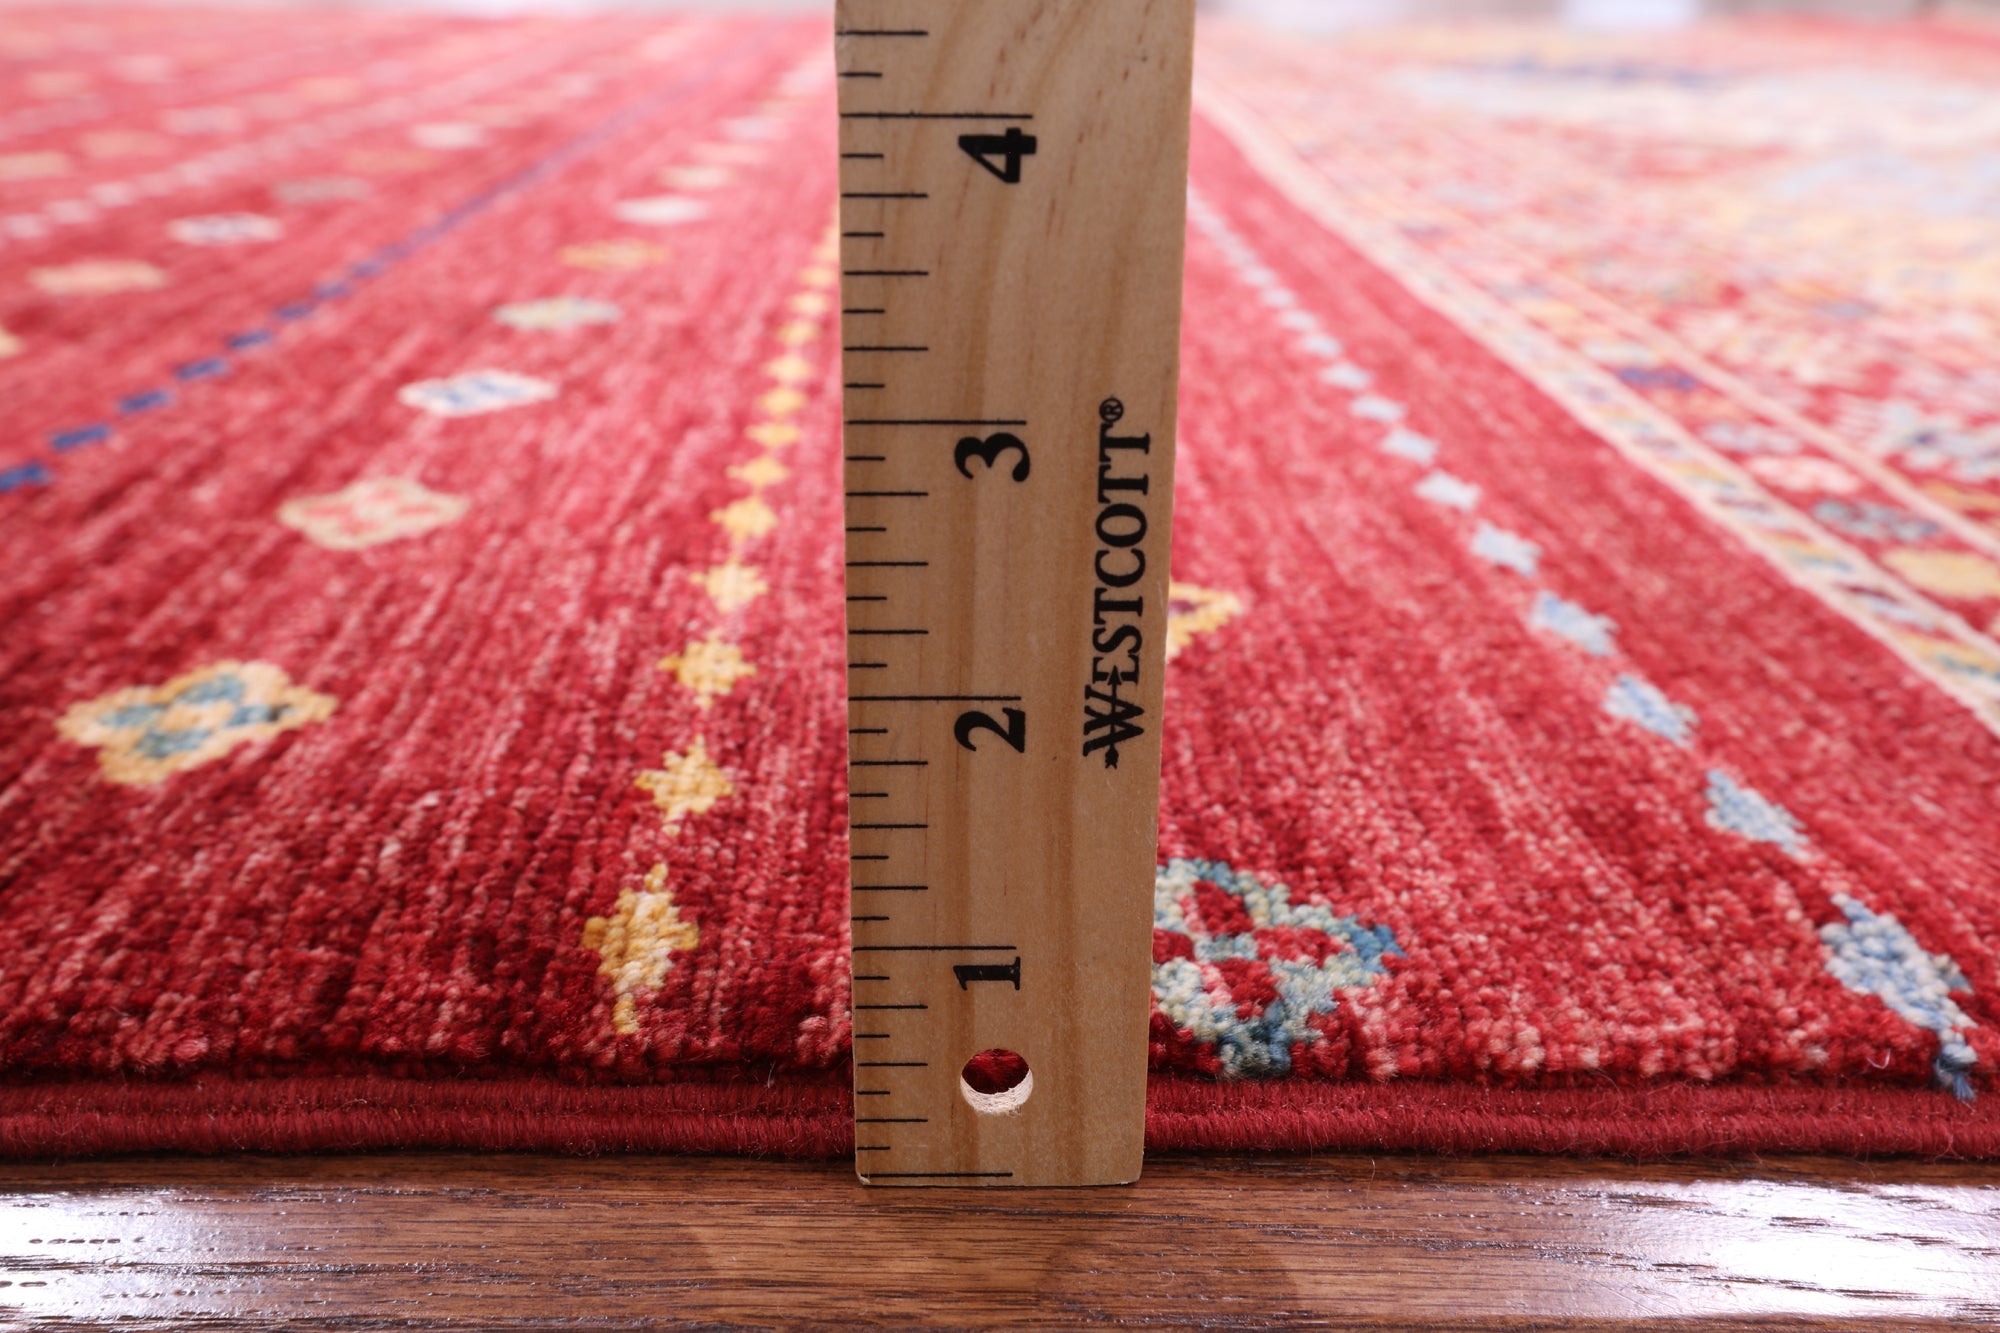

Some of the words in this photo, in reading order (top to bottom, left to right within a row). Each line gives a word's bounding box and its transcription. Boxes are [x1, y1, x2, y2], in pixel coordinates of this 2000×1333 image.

[957, 127, 1037, 184] 4
[953, 431, 1031, 483] 3
[953, 706, 1026, 754] 2
[952, 955, 1022, 991] 1
